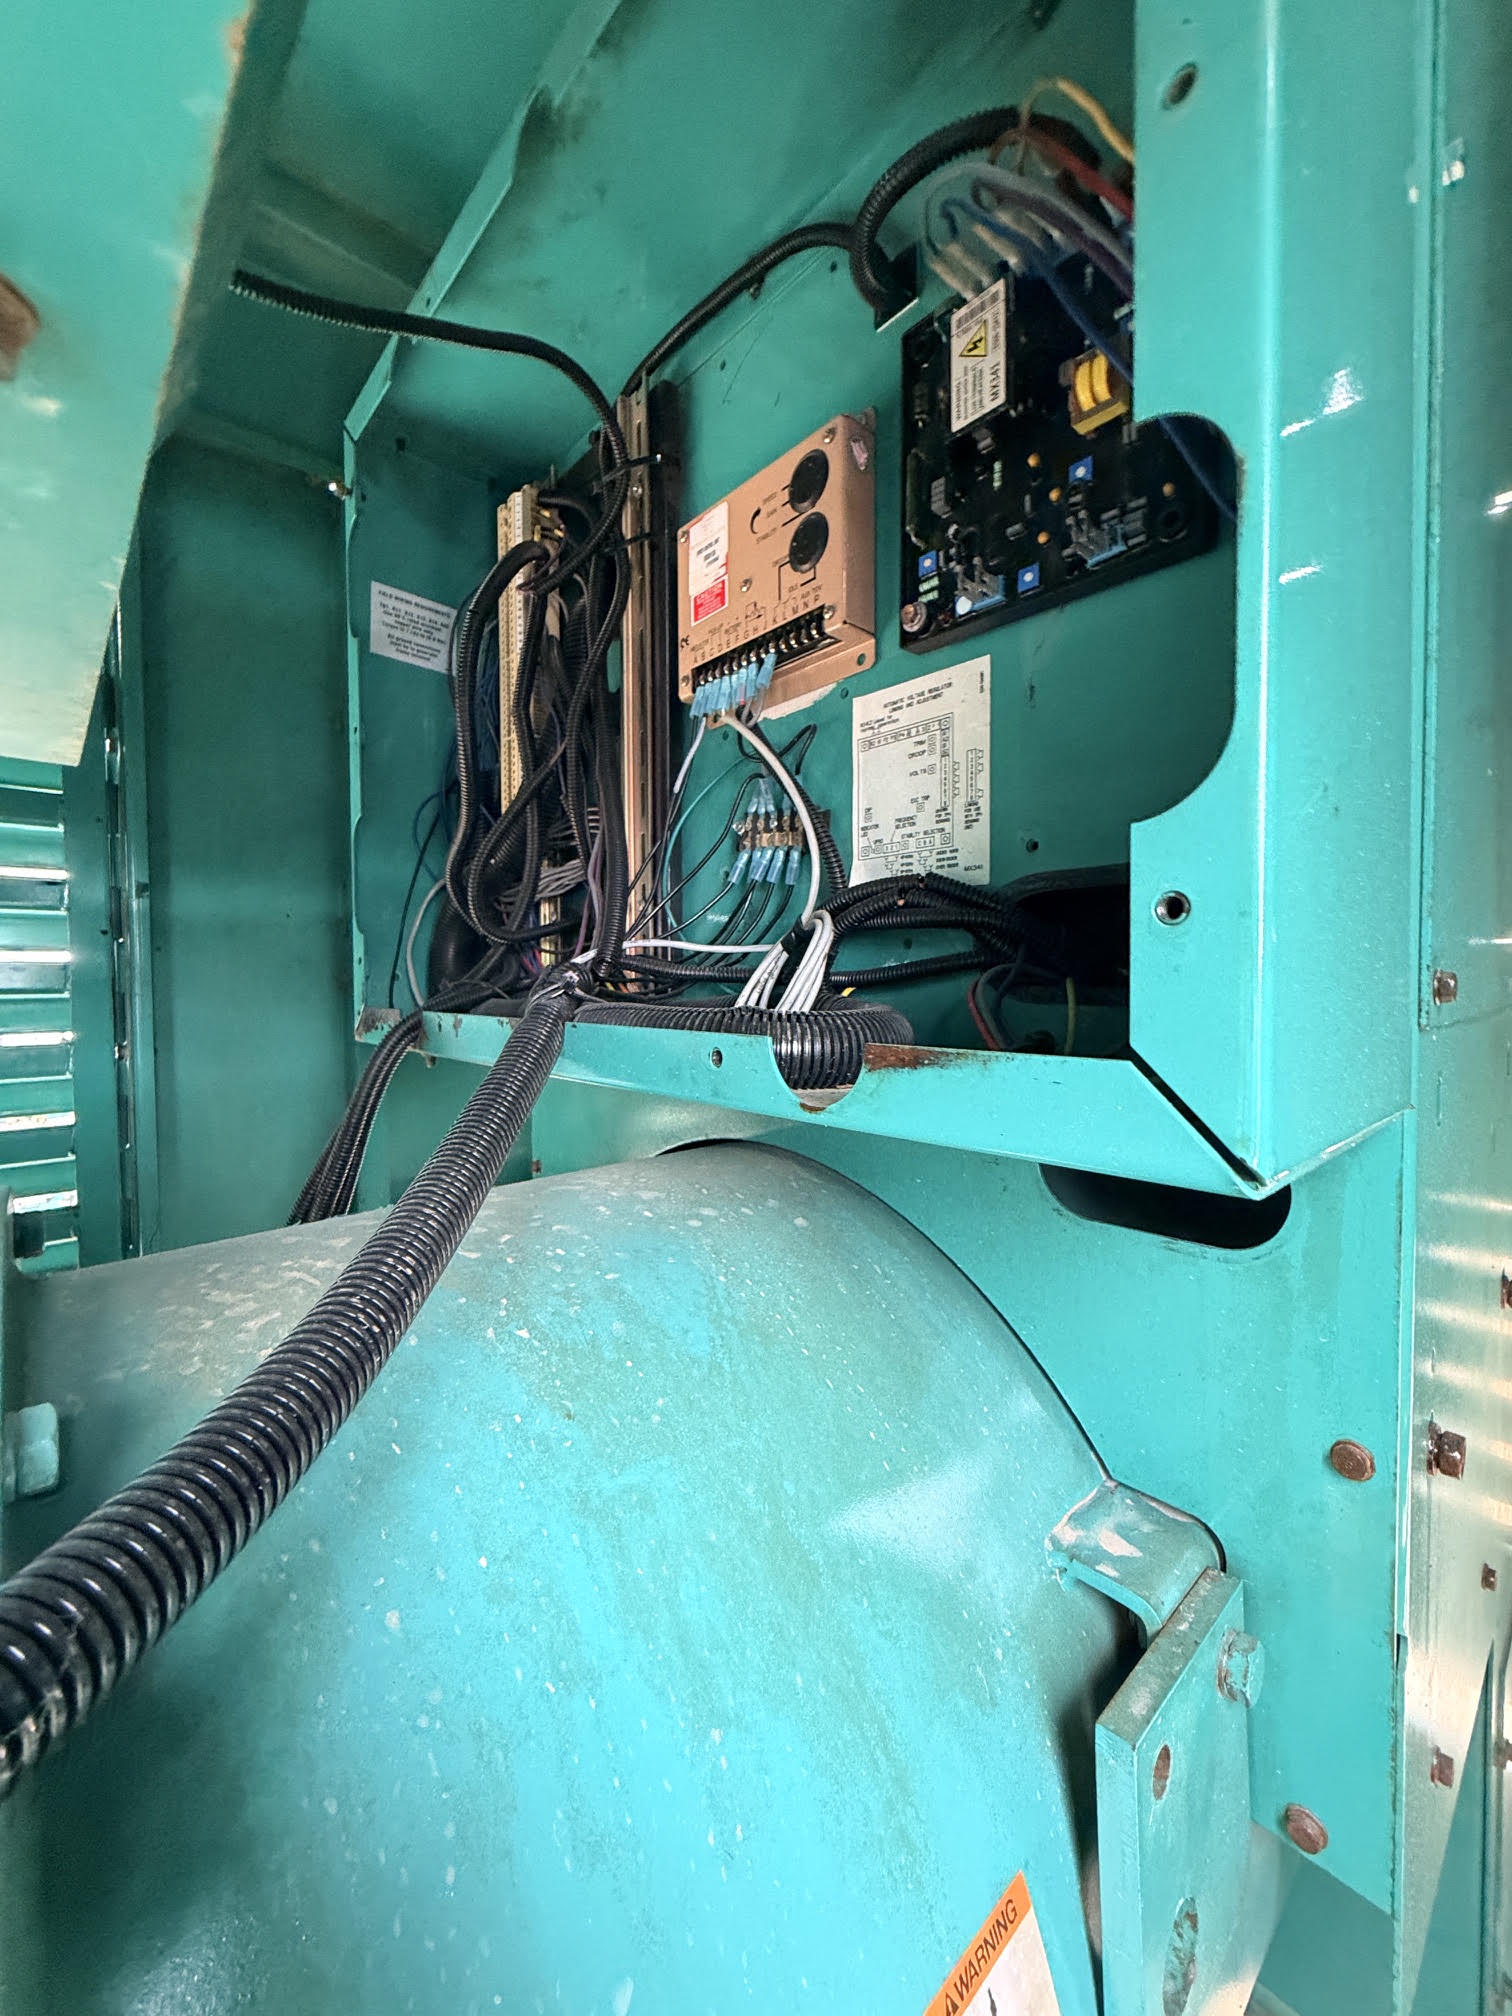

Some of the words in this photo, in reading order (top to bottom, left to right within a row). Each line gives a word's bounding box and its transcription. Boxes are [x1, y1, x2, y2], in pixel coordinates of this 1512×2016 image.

[989, 362, 1001, 402] MX341
[908, 749, 926, 760] DROOP
[954, 1899, 1018, 2001] WARNING
